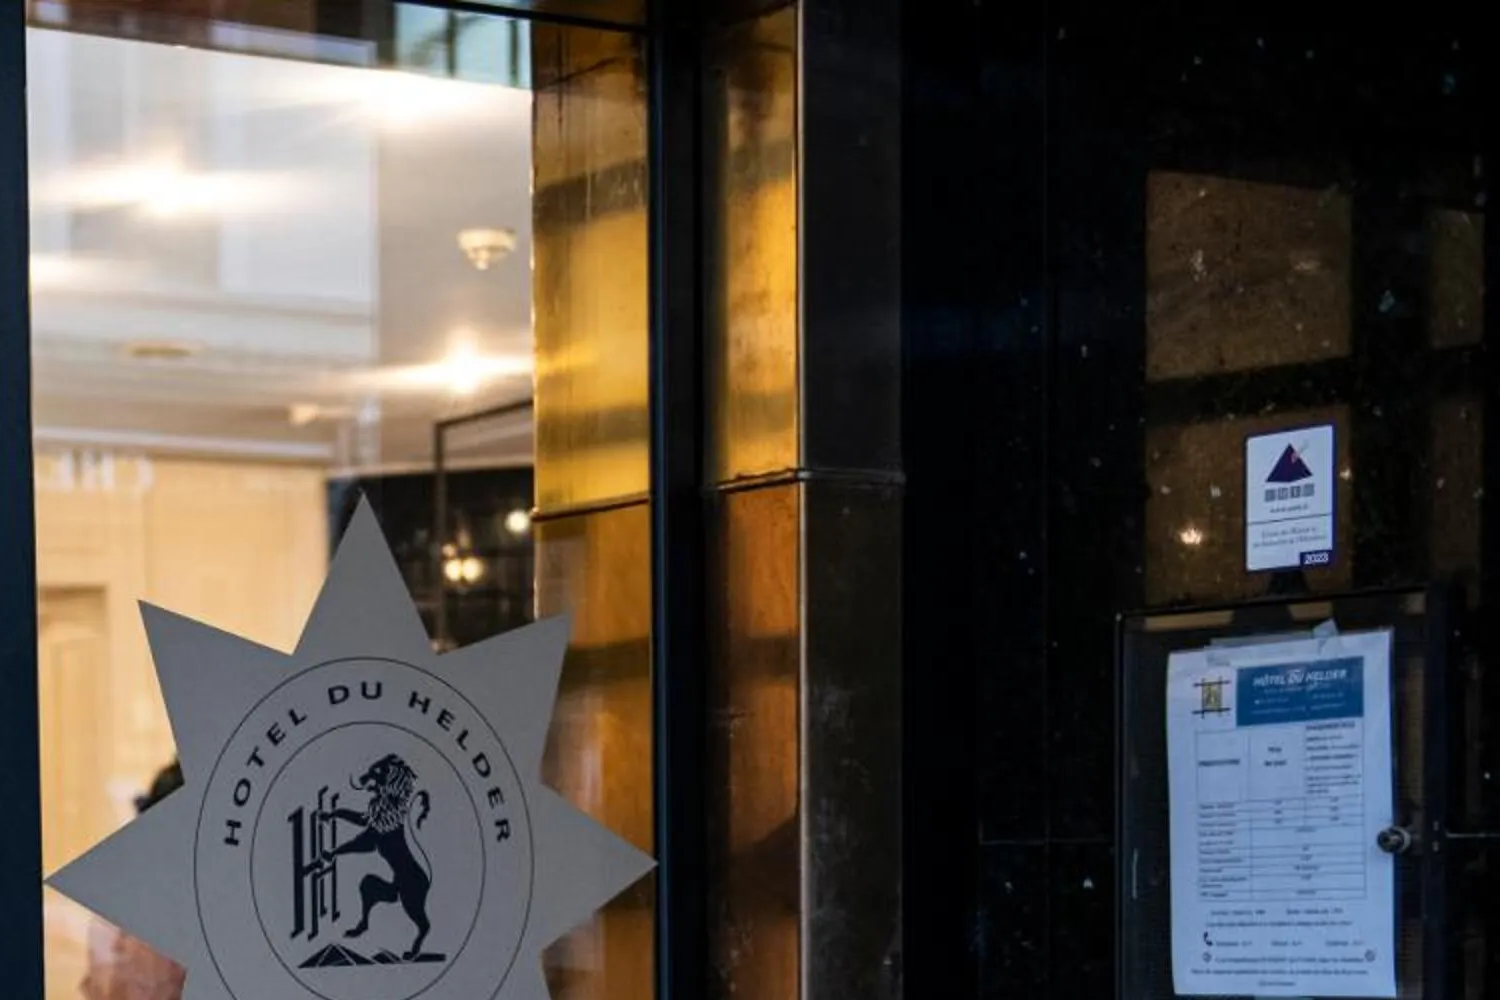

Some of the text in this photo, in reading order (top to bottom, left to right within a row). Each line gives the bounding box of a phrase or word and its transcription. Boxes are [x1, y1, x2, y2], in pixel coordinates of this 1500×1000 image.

[223, 681, 512, 848] HOTEL DU HELDER
